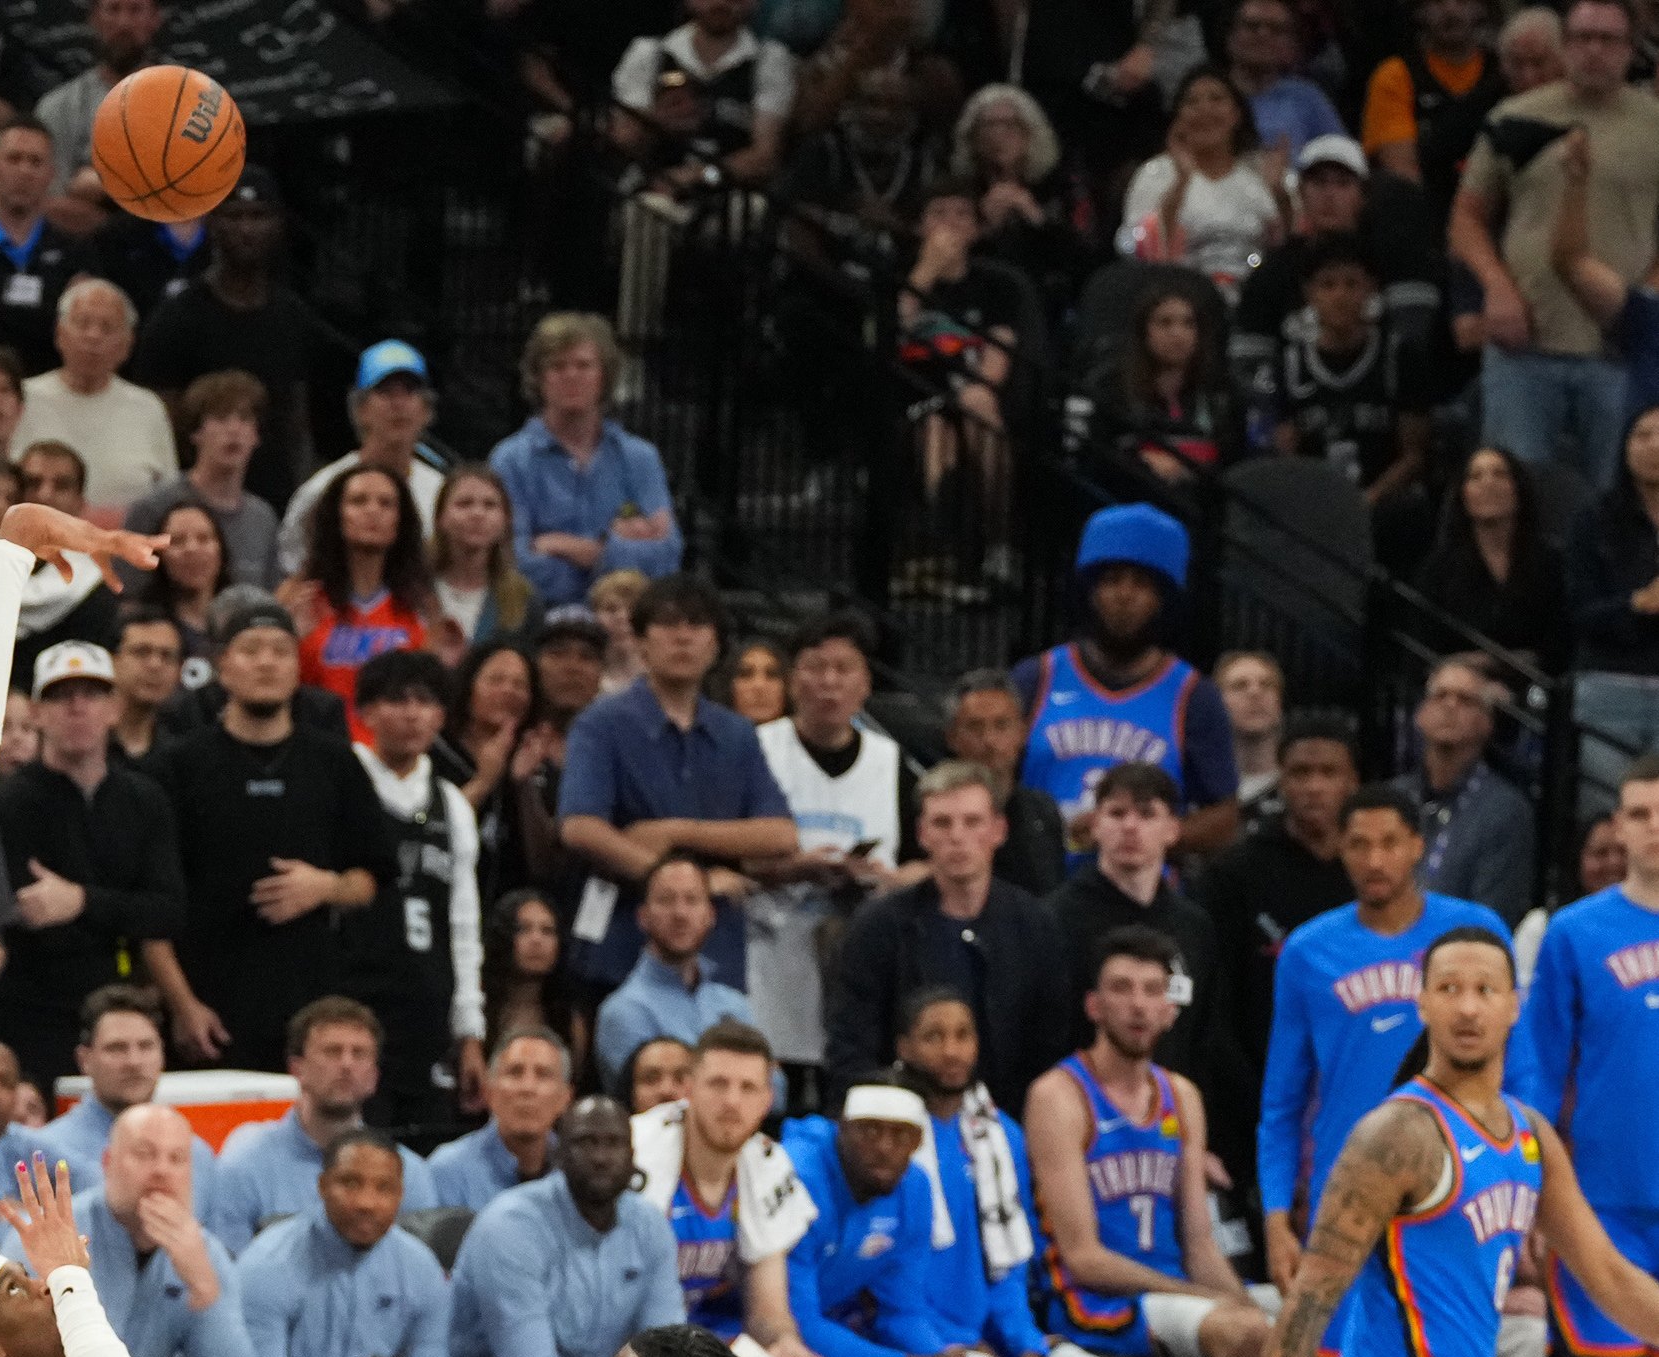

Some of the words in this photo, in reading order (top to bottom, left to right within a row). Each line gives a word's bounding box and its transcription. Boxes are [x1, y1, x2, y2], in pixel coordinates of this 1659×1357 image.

[1045, 717, 1167, 764] THUNDER
[1333, 960, 1424, 1014] THUND
[1087, 1150, 1179, 1200] THUNDE
[1128, 1193, 1155, 1252] 7
